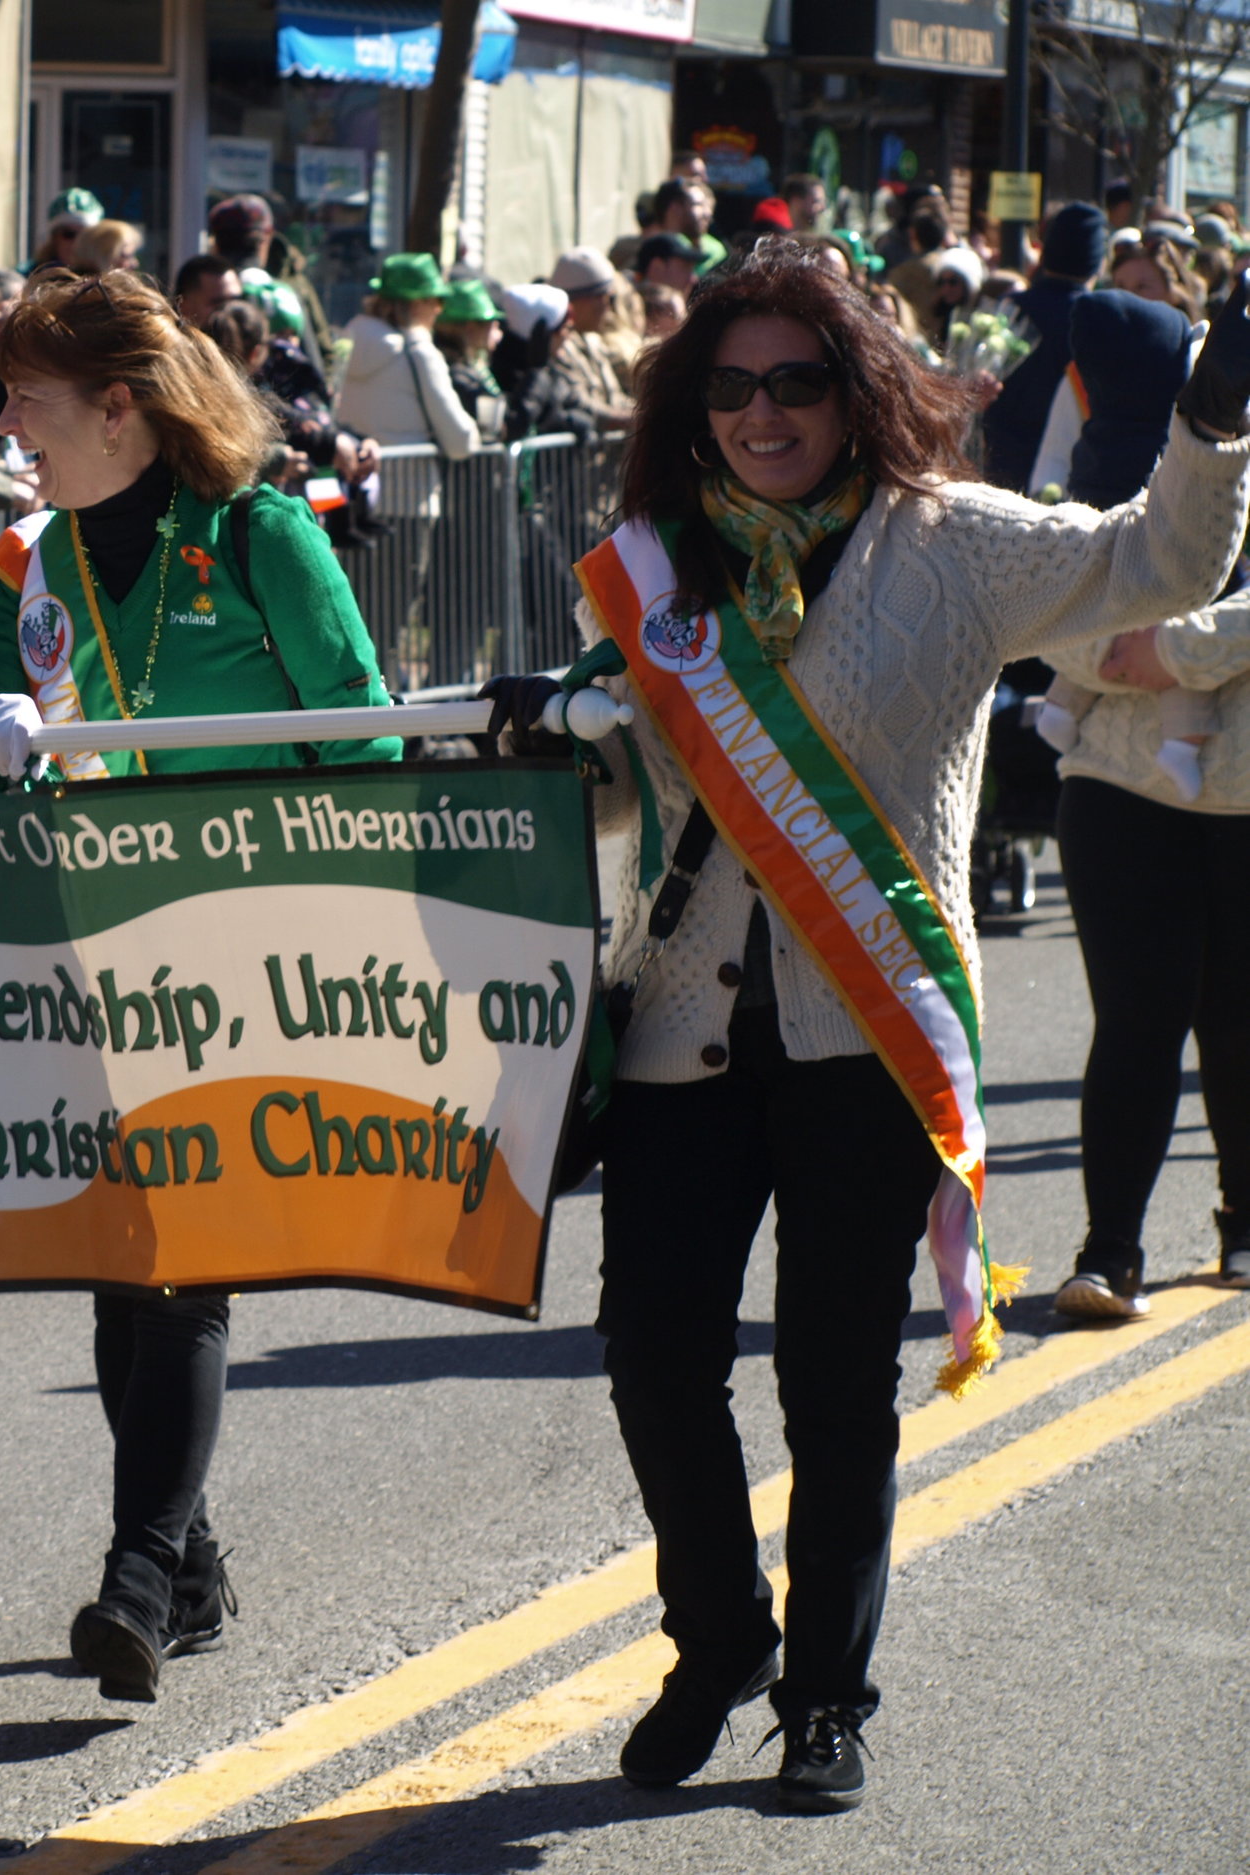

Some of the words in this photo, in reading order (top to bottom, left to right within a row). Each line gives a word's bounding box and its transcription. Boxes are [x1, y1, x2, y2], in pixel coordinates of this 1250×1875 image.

[170, 611, 216, 626] Ireland
[17, 812, 180, 871] Order
[201, 807, 260, 873] of
[273, 793, 536, 854] Hibernians
[688, 675, 872, 913] FINANCIAL
[858, 910, 932, 1006] SEC.
[264, 953, 450, 1065] Unity
[478, 960, 576, 1049] and
[250, 1091, 500, 1214] Charity
